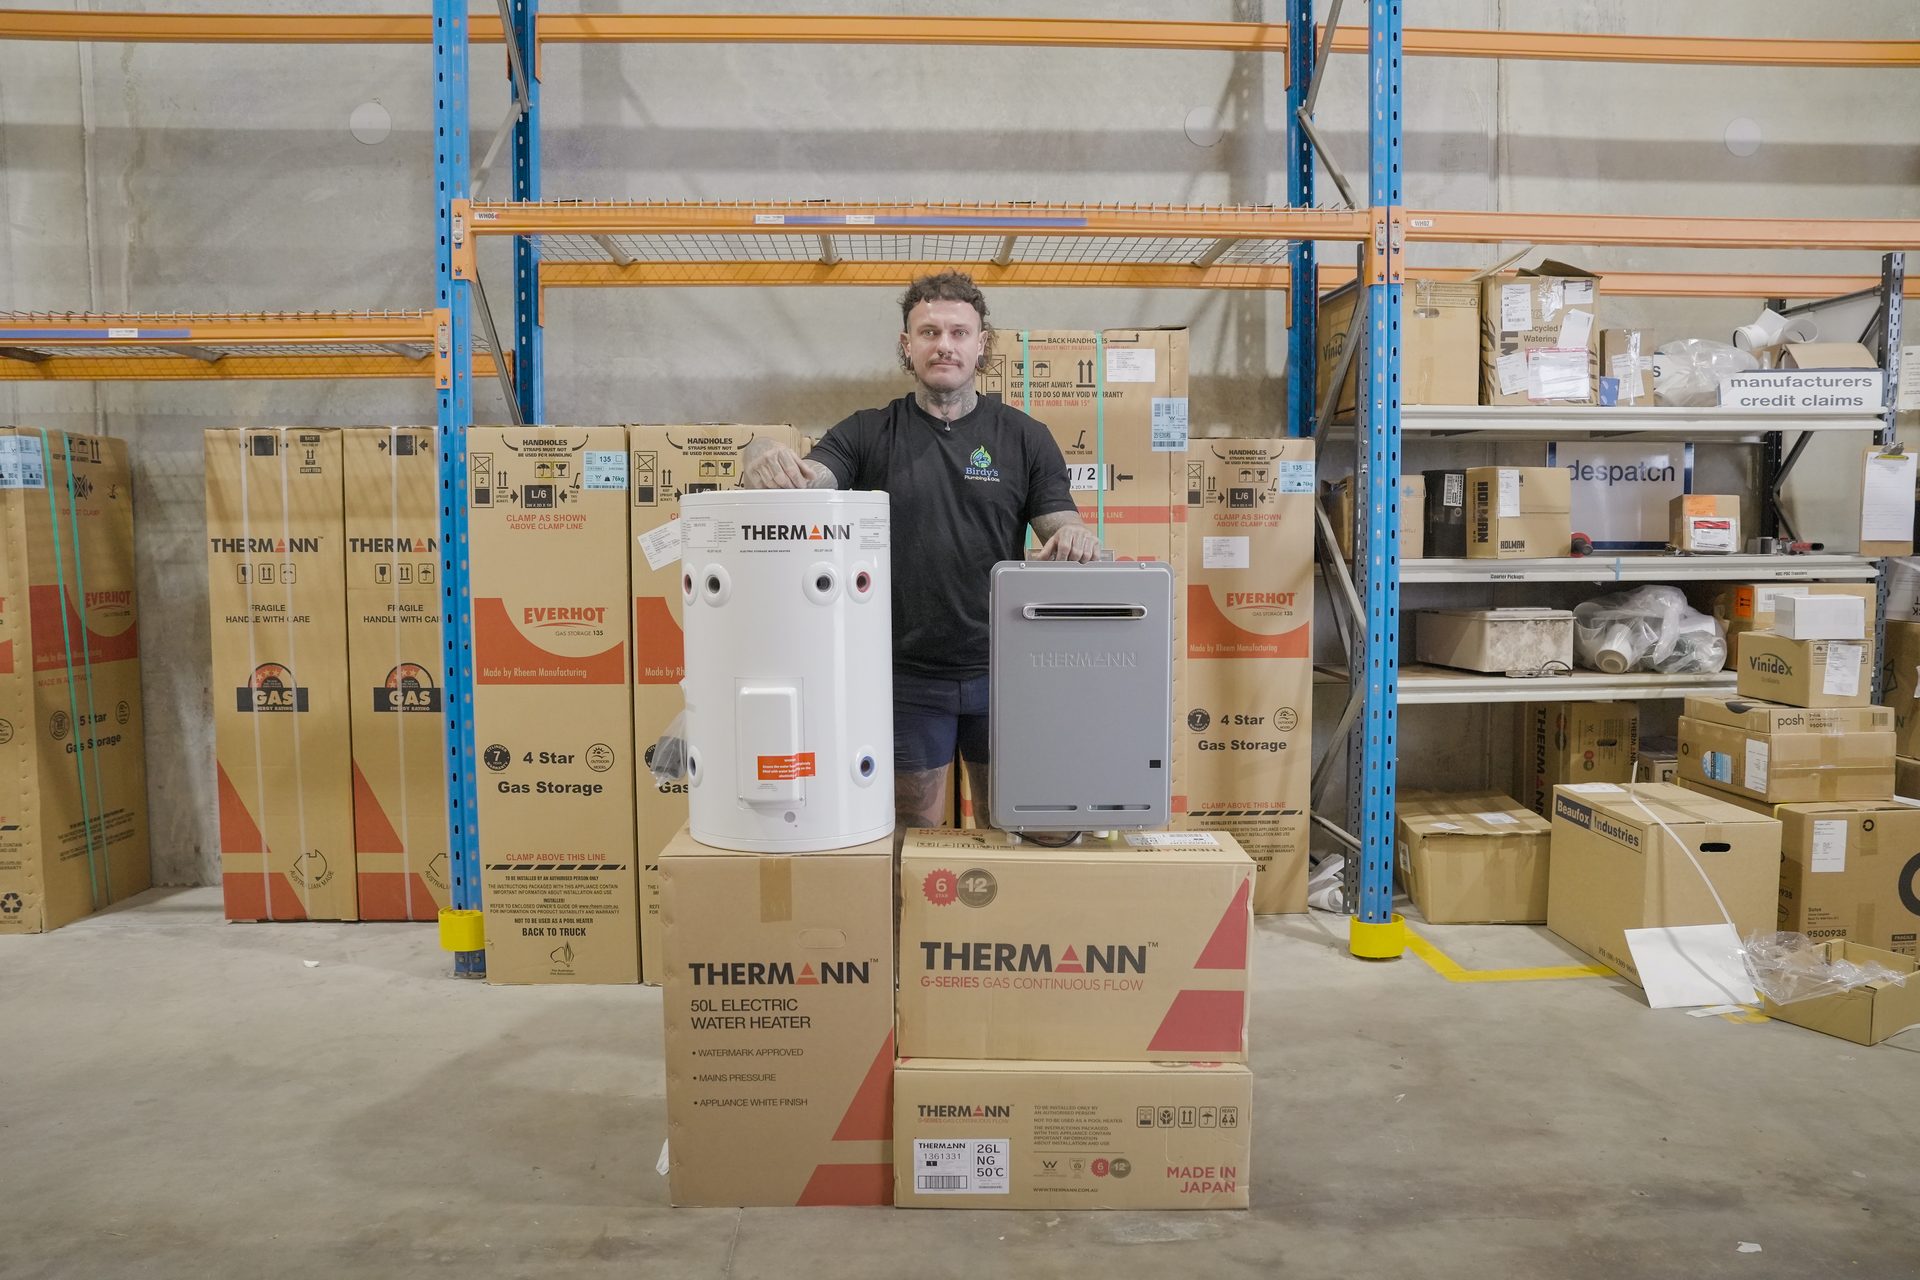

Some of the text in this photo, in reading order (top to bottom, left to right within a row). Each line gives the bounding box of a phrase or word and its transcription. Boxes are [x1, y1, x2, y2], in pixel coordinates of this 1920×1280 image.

[1523, 335, 1557, 344] Watering
[1731, 375, 1873, 388] manufacturers
[1740, 394, 1863, 407] credit claims
[966, 467, 999, 477] Birdy's
[612, 475, 625, 483] 76kg
[531, 489, 547, 499] L/6
[1477, 481, 1488, 543] HOLMAN
[741, 524, 850, 540] THERMANN
[210, 538, 319, 553] THERMANN
[1500, 540, 1525, 549] HOLMAN
[84, 590, 132, 609] EVERHOT
[1226, 592, 1295, 607] EVERHOT
[523, 607, 606, 624] EVERHOT
[1190, 644, 1205, 652] Made
[1207, 644, 1214, 653] by
[1749, 656, 1793, 676] Vinidex
[483, 667, 587, 678] Made by Rheem Manufacturing
[645, 667, 674, 678] Made by
[254, 690, 294, 706] GAS
[388, 690, 431, 706] GAS
[1195, 714, 1201, 723] 7
[1221, 715, 1264, 725] 4 Star
[1777, 713, 1805, 729] posh
[1198, 740, 1287, 752] Gas Storage
[493, 751, 501, 762] 7
[523, 752, 575, 764] 4 Star
[497, 781, 603, 796] Gas Storage
[1557, 799, 1590, 825] Beaufox
[1594, 815, 1640, 847] Industries
[936, 878, 946, 892] 6
[965, 877, 988, 893] 12
[522, 928, 586, 936] BACK TO TRUCK
[1807, 929, 1847, 938] 9500938
[920, 941, 1146, 974] THERMANN
[688, 961, 870, 986] THERMANN
[920, 976, 1144, 991] G-SERIES GAS CONTINUOUS FLOW
[691, 999, 798, 1012] 50L ELECTRIC
[691, 1016, 811, 1029] WATER HEATER
[699, 1049, 753, 1057] WATERMARK
[699, 1074, 776, 1082] MAINS PRESSURE
[700, 1098, 808, 1107] APPLIANCE WHITE FINISH
[918, 1105, 1010, 1117] THERMANN
[977, 1144, 1000, 1153] 26L
[977, 1156, 995, 1165] NG
[1114, 1163, 1126, 1171] 12
[1167, 1167, 1236, 1178] MADE IN
[1180, 1182, 1235, 1193] JAPAN
